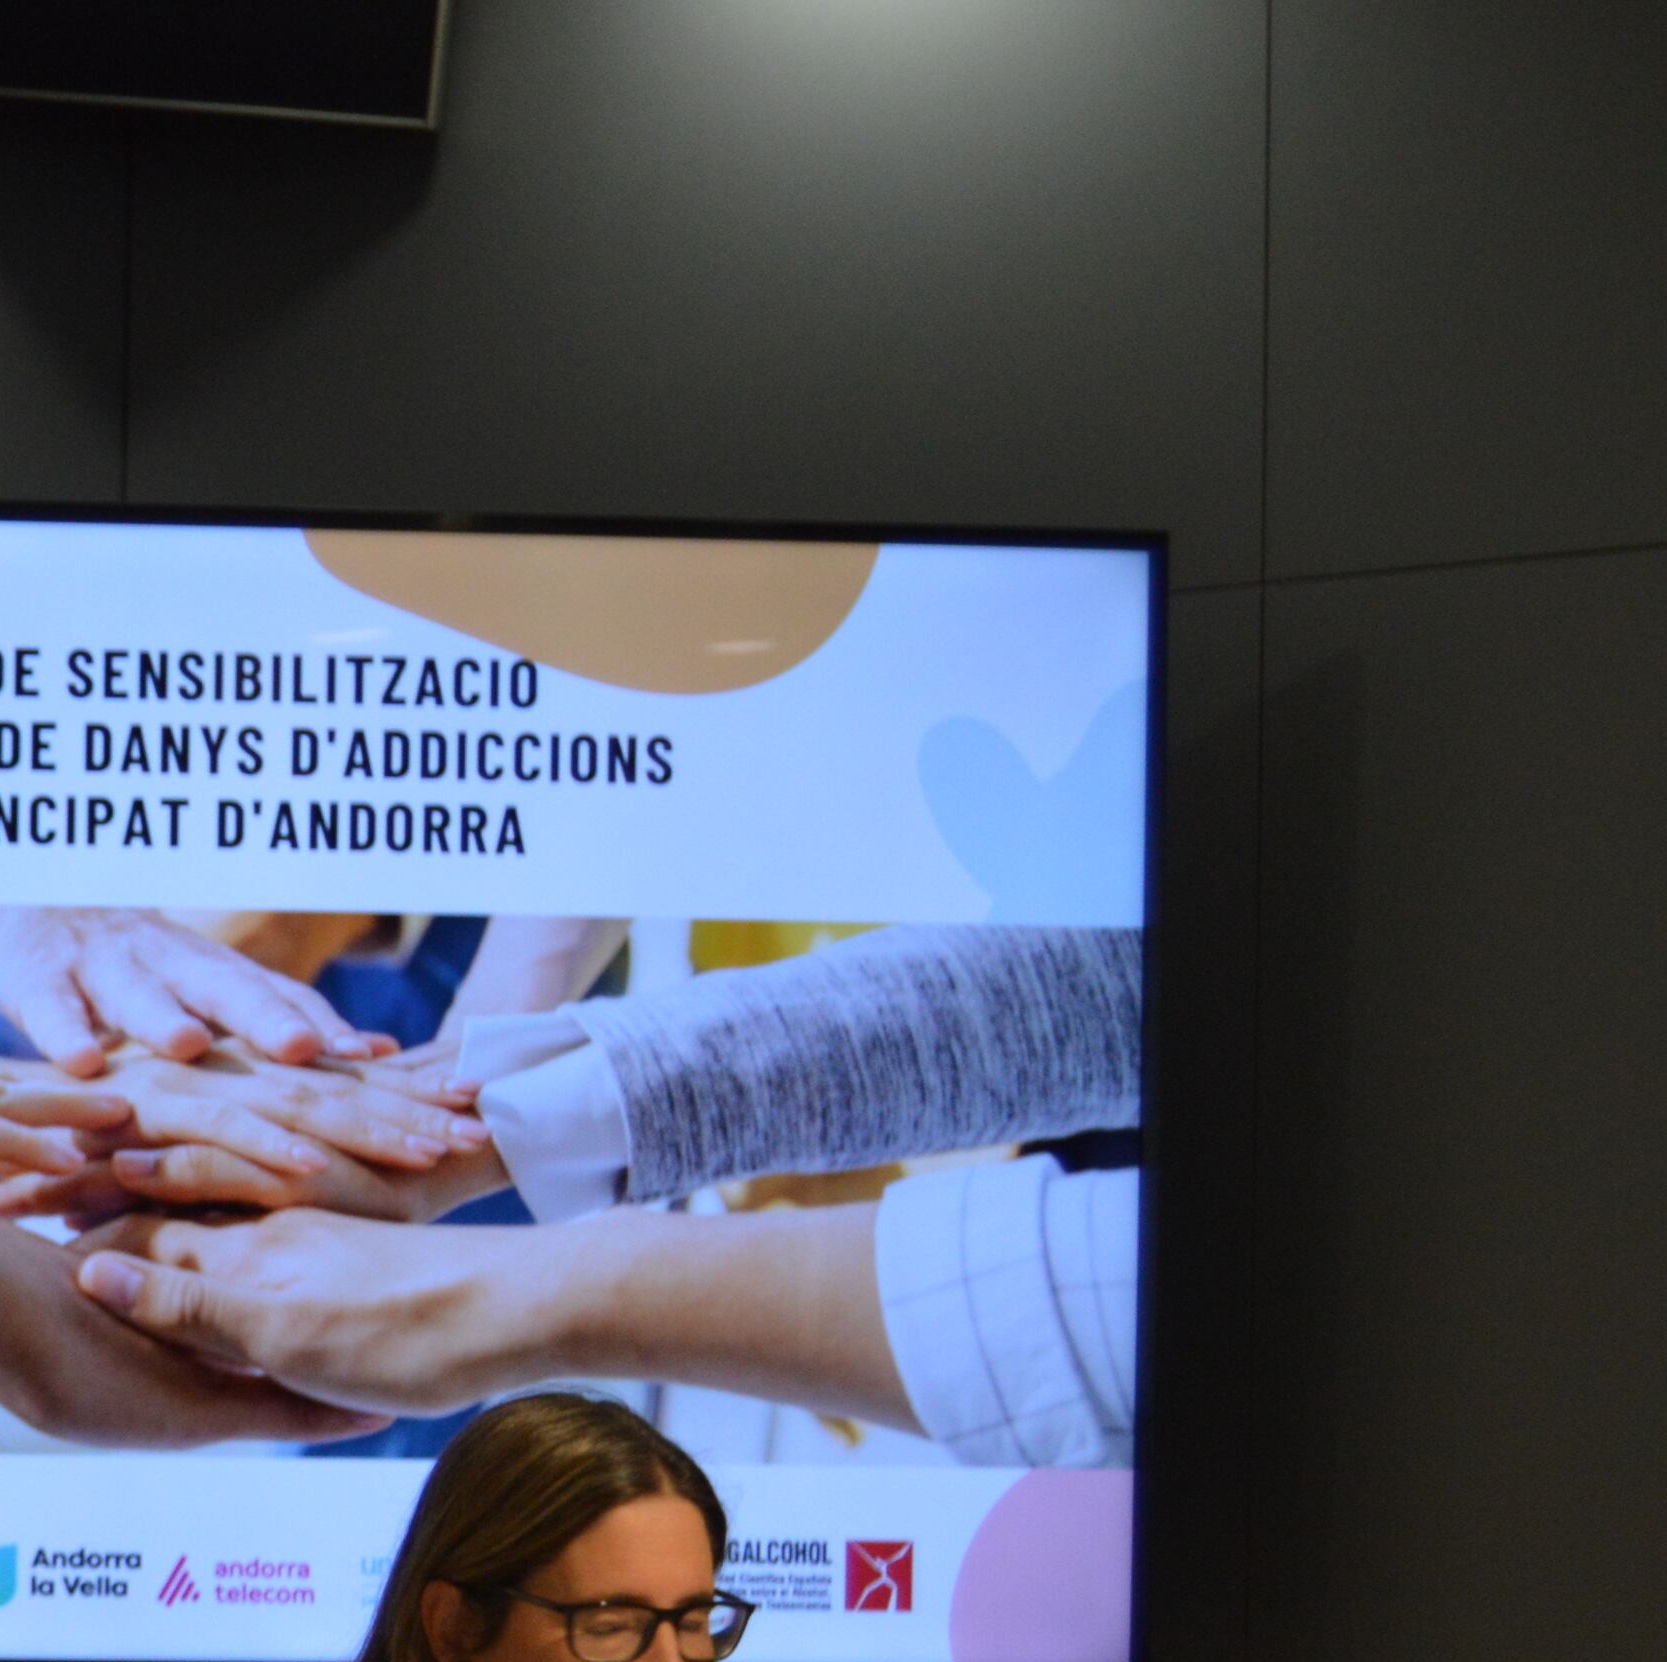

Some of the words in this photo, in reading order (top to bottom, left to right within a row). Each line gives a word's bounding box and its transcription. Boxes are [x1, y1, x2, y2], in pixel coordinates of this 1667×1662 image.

[67, 649, 538, 709] SENSIBILITZACIO
[84, 723, 264, 776] DANYS
[291, 728, 673, 786] D'ADDICCIONS
[216, 799, 526, 855] D'ANDORRA
[32, 1548, 142, 1571] Andorra
[727, 1540, 833, 1564] GALCOHOL
[215, 1558, 310, 1579] andorra
[31, 1575, 55, 1596] la
[63, 1575, 128, 1597] Vella
[215, 1584, 316, 1605] telecom
